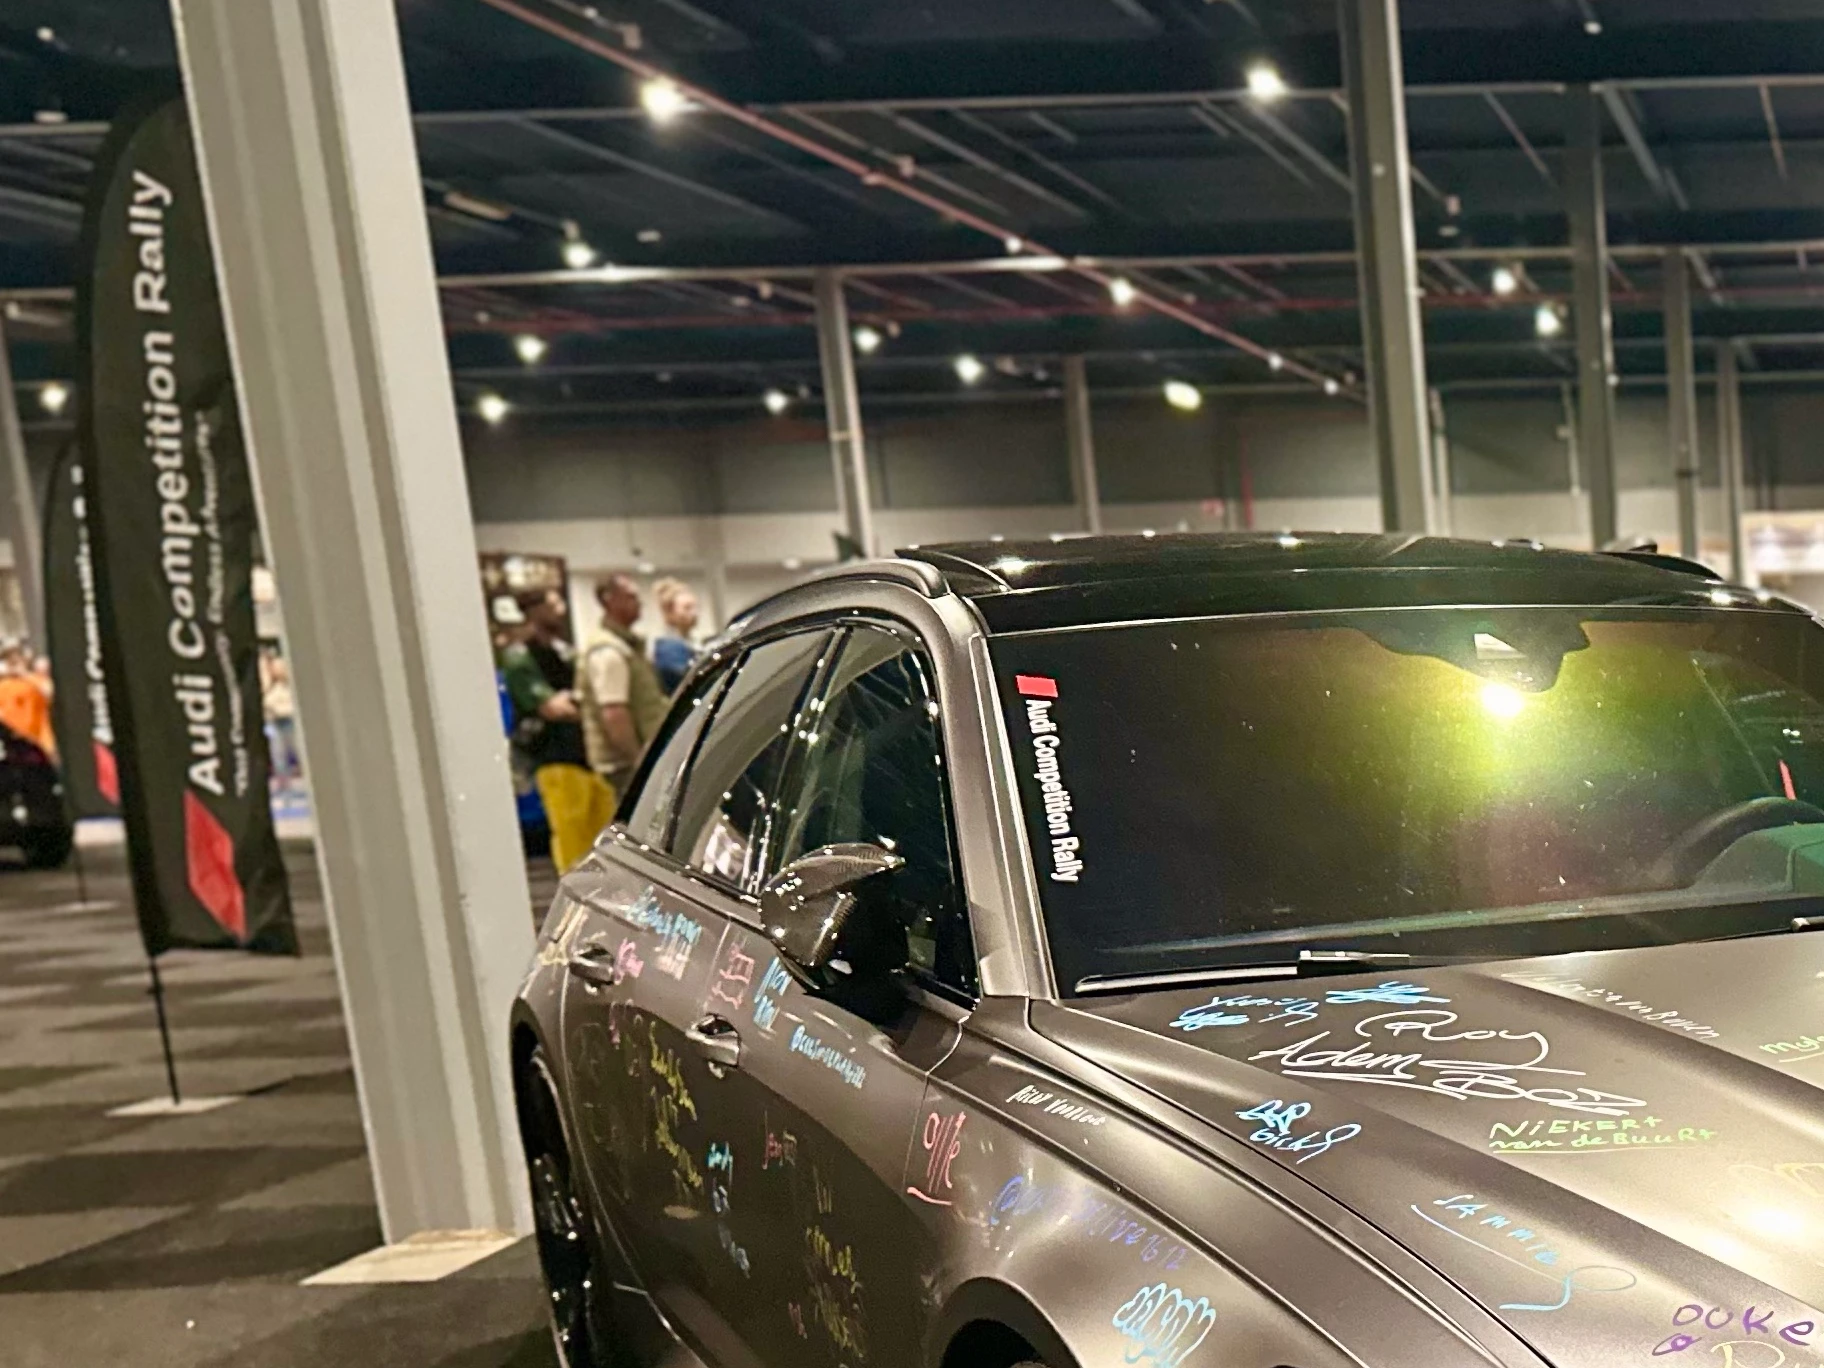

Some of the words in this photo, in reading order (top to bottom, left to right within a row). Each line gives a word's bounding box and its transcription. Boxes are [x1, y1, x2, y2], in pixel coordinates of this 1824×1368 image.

[128, 169, 172, 314] Rally
[143, 331, 206, 660] Competition
[172, 674, 224, 796] Audi
[1025, 700, 1057, 734] Audi
[1032, 735, 1073, 836] Competition
[1051, 837, 1083, 884] Rally
[1355, 1010, 1587, 1076] Roy
